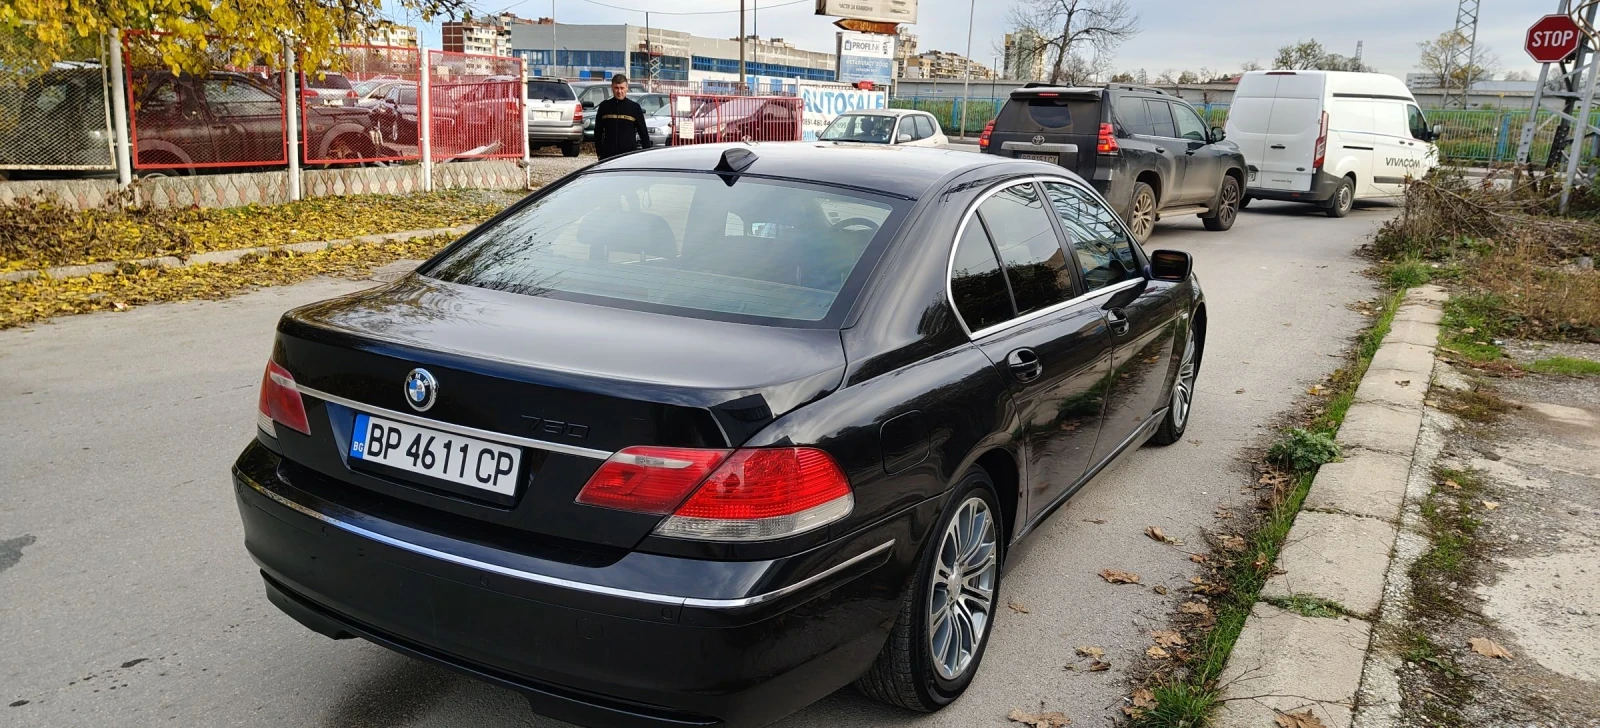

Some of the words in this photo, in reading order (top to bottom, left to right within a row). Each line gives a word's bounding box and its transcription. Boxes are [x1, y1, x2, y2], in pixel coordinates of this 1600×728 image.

[1531, 30, 1574, 47] STOP
[802, 88, 885, 115] AUTOSALE
[1385, 157, 1420, 168] VIVACOM
[353, 441, 364, 453] BG
[367, 422, 402, 460] BP
[405, 433, 470, 478] 4611
[475, 448, 514, 486] CP
